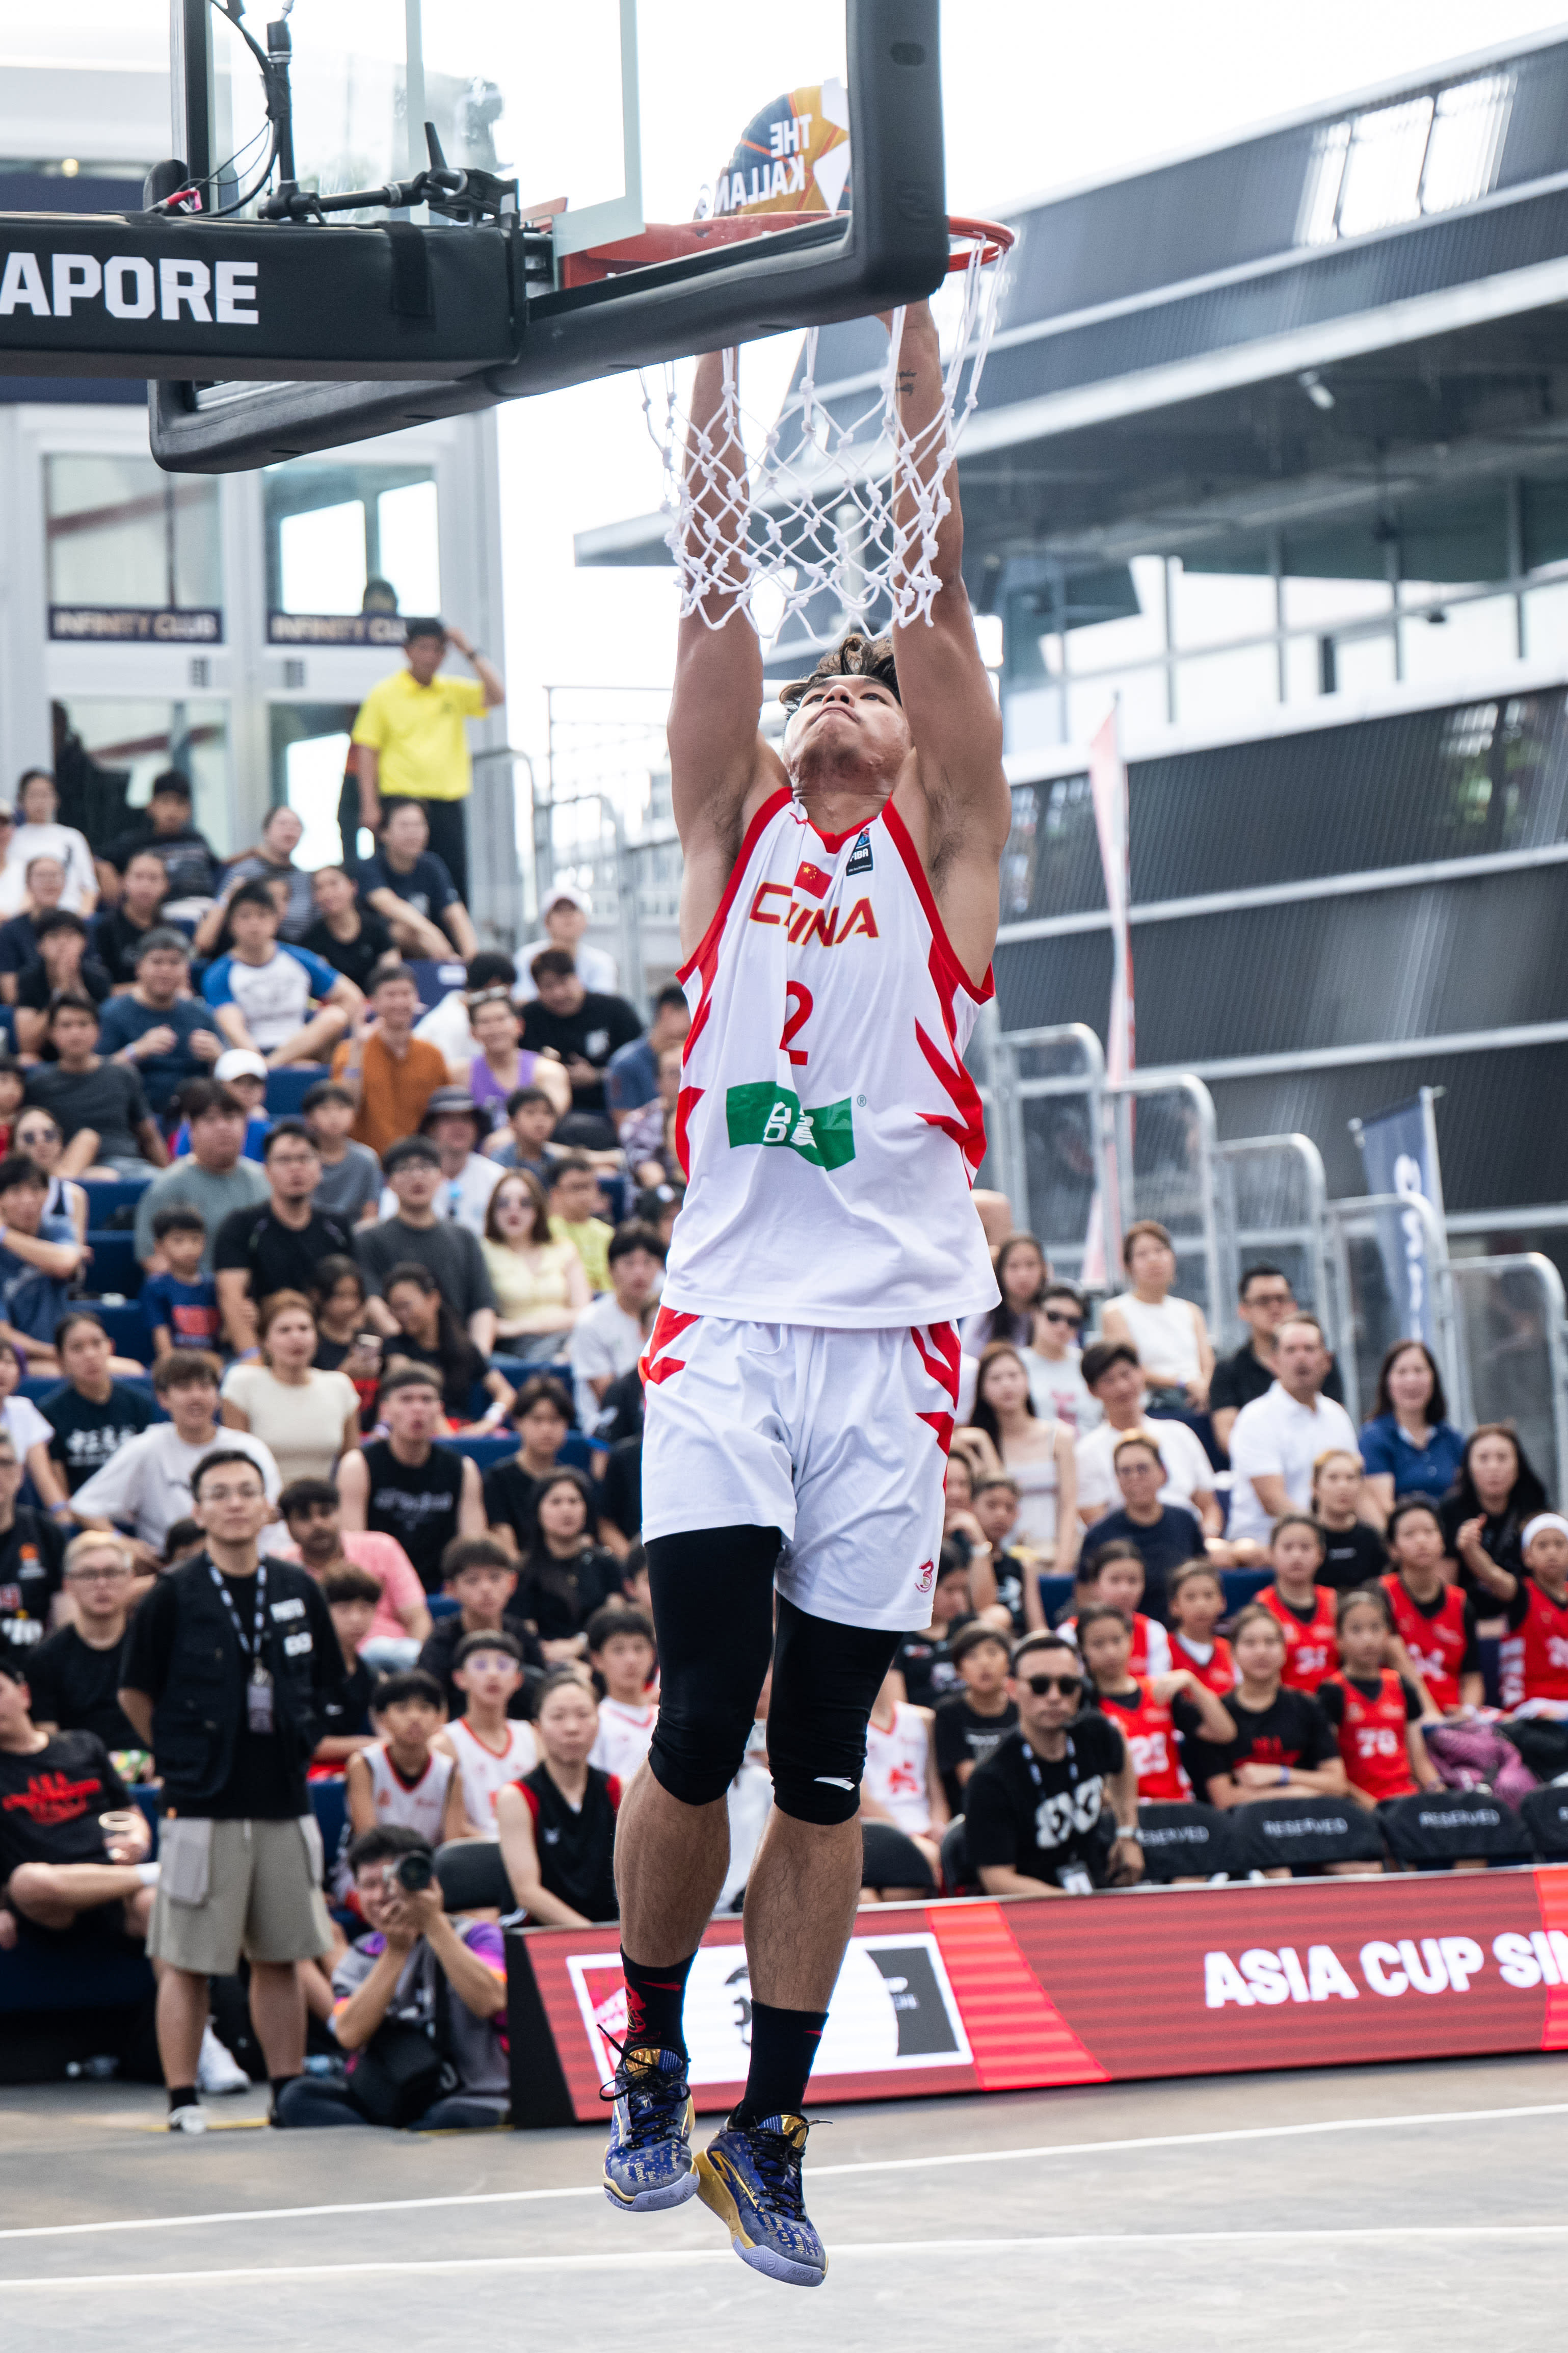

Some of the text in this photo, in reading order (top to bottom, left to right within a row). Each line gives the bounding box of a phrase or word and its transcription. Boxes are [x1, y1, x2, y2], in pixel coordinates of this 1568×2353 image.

[0, 252, 259, 325] APORE
[1262, 1817, 1348, 1837] RESERVED
[1204, 1944, 1360, 2008] ASIA
[1359, 1936, 1484, 1997] CUP
